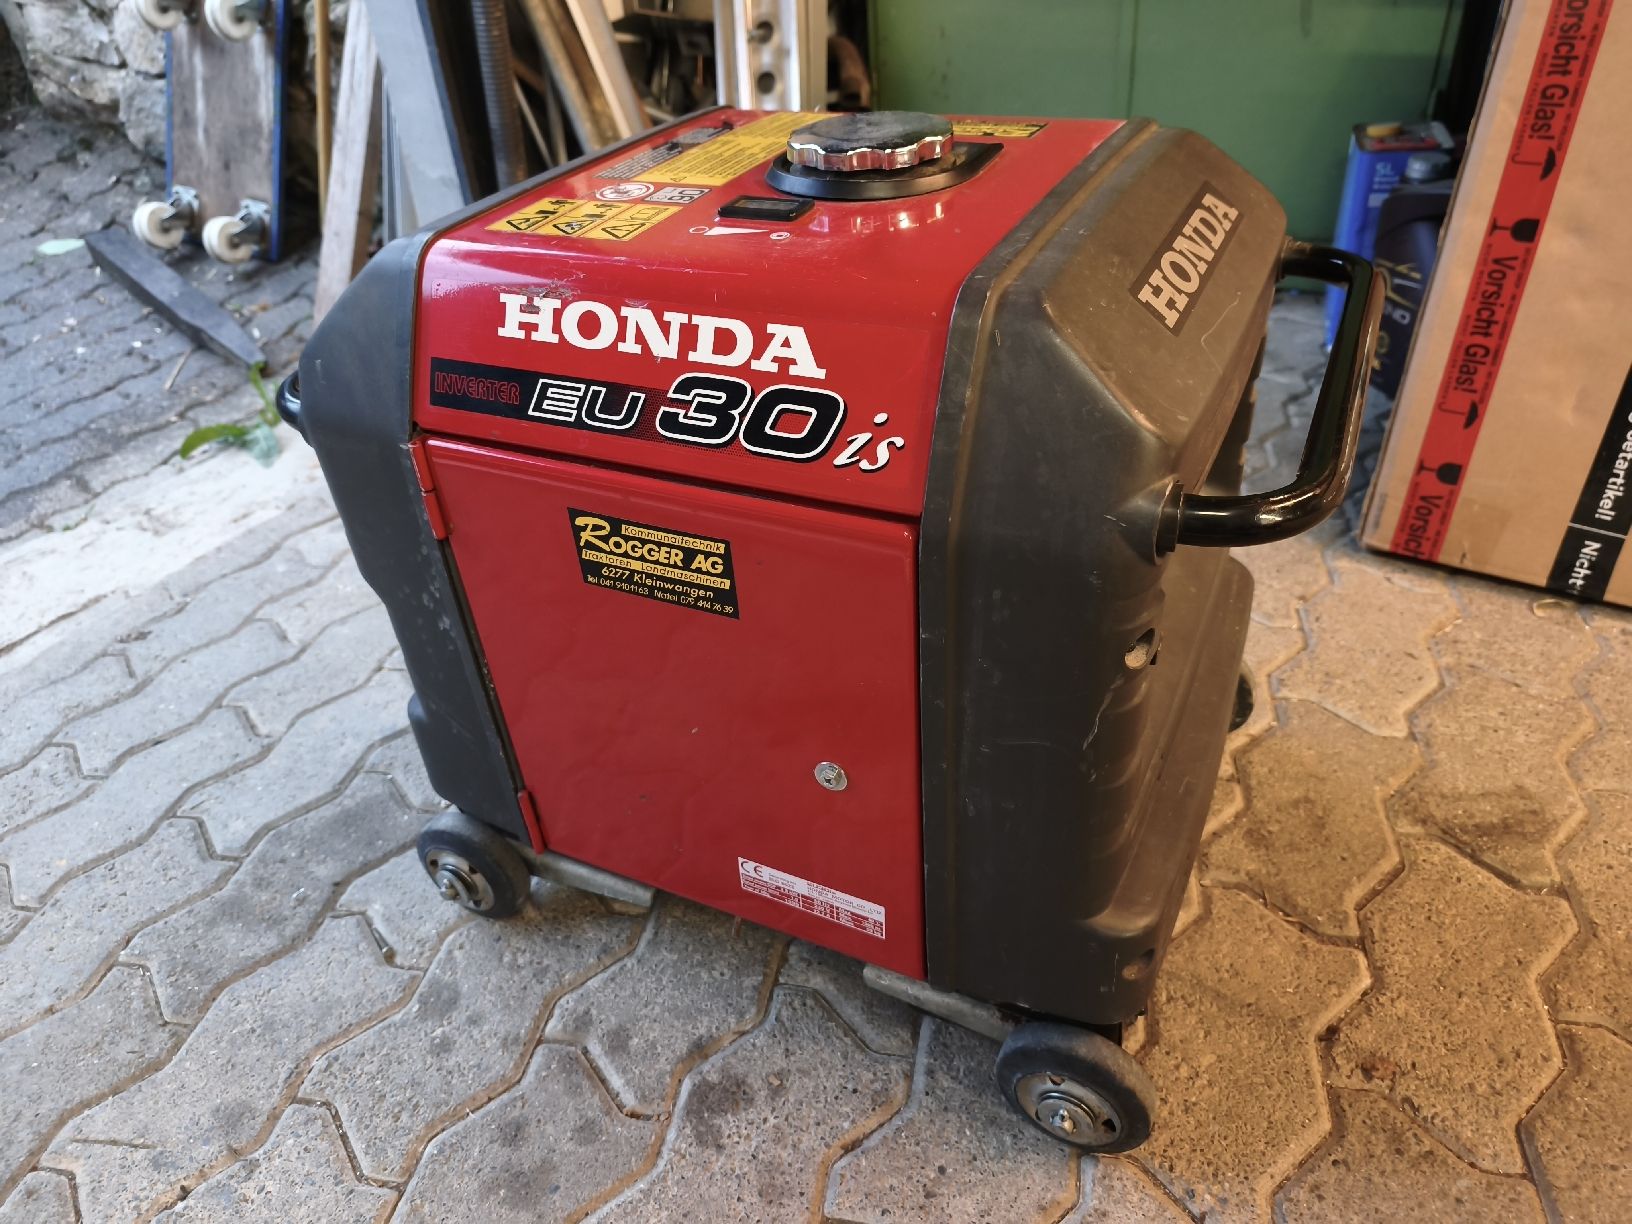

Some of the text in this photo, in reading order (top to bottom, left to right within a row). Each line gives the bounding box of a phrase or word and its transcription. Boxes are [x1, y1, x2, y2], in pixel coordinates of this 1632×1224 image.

[1546, 0, 1588, 77] orsicht
[1528, 83, 1570, 141] Glas!
[1138, 193, 1238, 328] HONDA
[1470, 256, 1519, 338] Vorsicht
[498, 293, 827, 379] HONDA
[1453, 343, 1491, 394] Glas!
[434, 371, 520, 404] INVERTER
[528, 378, 646, 430] EU
[575, 516, 724, 574] ROGGER AG
[624, 526, 722, 552] Kommunaltechnik
[1568, 540, 1602, 586] Nicht
[583, 550, 726, 588] Traktoren Landmaschinen
[600, 578, 614, 587] 041
[654, 590, 678, 602] Natel
[681, 596, 695, 605] 079
[697, 600, 711, 609] 414
[712, 603, 722, 612] 76
[723, 605, 734, 614] 39
[602, 566, 714, 598] 6277 Kleinwangen
